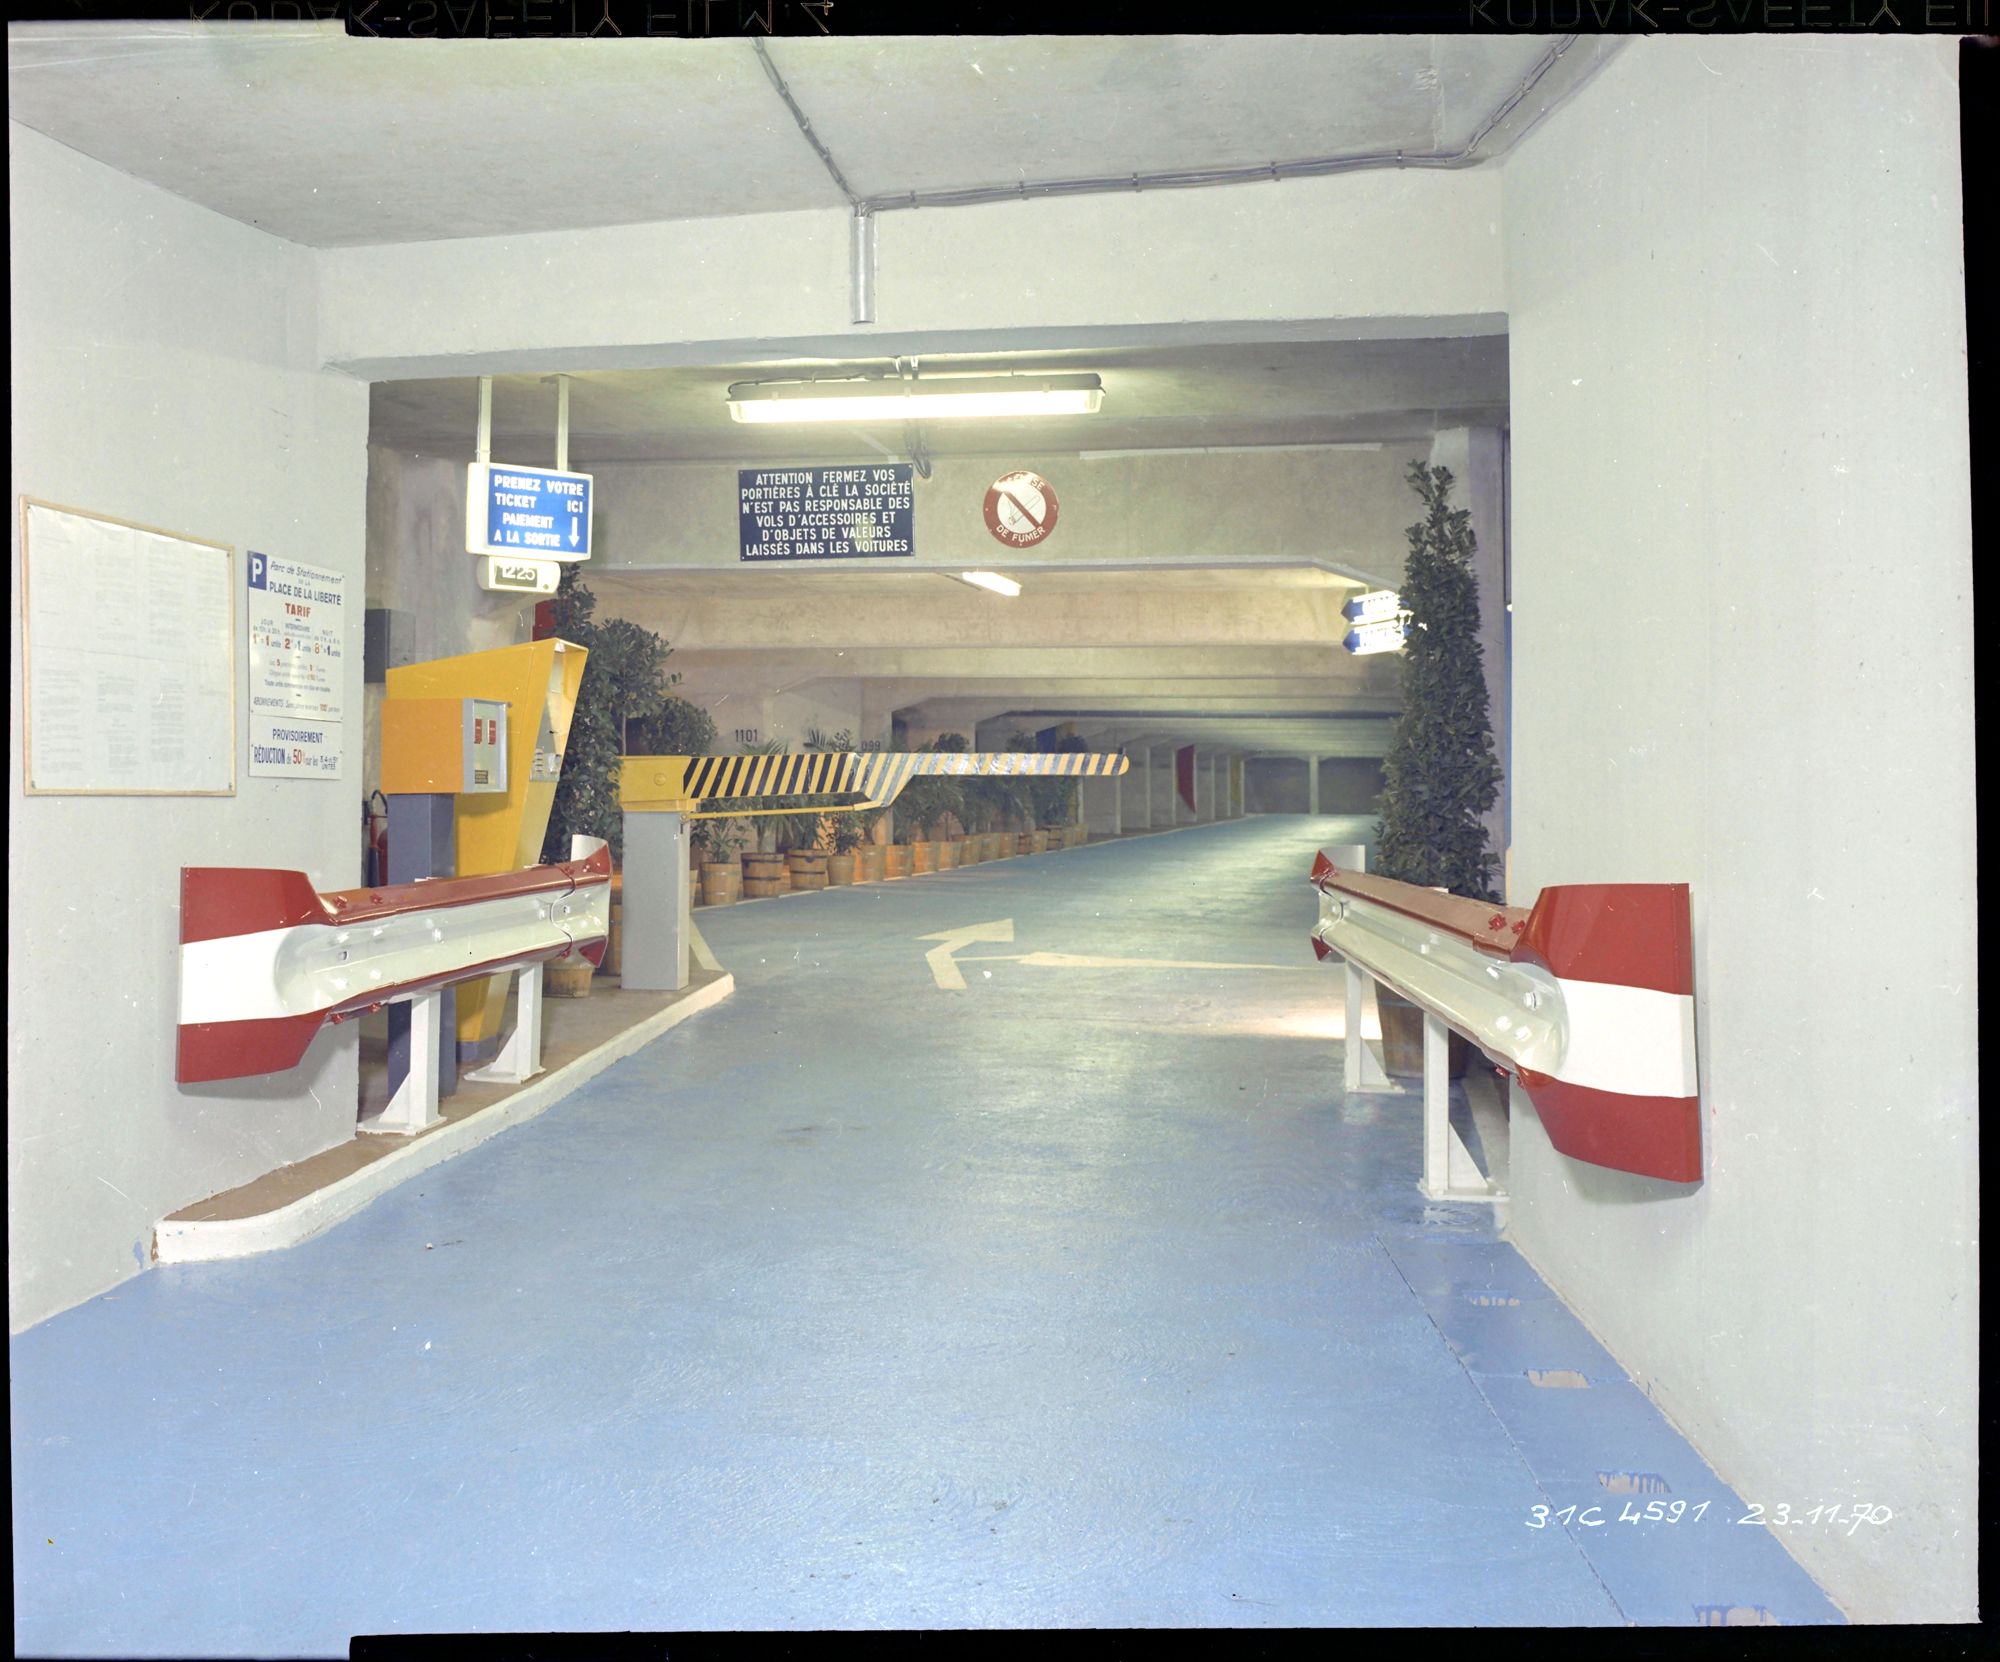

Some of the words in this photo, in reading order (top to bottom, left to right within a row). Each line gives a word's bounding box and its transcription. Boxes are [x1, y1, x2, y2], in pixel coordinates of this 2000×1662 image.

[494, 474, 541, 492] PRENEZ
[546, 480, 584, 496] VOTRE
[756, 472, 813, 486] ATTENTION
[823, 470, 866, 483] FERMEZ
[873, 469, 895, 481] VOS
[1030, 478, 1045, 490] SE
[819, 483, 839, 497] CLÉ
[846, 484, 859, 496] LA
[865, 480, 911, 496] SOCIÉTÉ
[495, 492, 537, 508] TICKET
[567, 500, 584, 513] ICI
[742, 501, 774, 514] N'EST
[779, 500, 800, 513] PAS
[805, 498, 883, 511] RESPONSABLE
[888, 497, 910, 509] DES
[502, 512, 554, 529] PAIEMENT
[756, 515, 784, 528] VOLS
[789, 512, 877, 526] D'ACCESSOIRES
[882, 511, 896, 523] ET
[494, 529, 502, 542] A
[506, 530, 520, 544] LA
[524, 531, 561, 547] SORTIE
[762, 528, 817, 541] D'OBJETS
[822, 527, 836, 539] DE
[842, 526, 891, 539] VALEURS
[996, 524, 1009, 538] DE
[1012, 526, 1046, 543] FUMER
[746, 541, 790, 556] LAISSÉS
[796, 542, 825, 554] DANS
[830, 541, 849, 554] LES
[855, 540, 908, 553] VOITURES
[252, 558, 263, 583] P
[270, 560, 285, 572] Parc
[287, 565, 295, 575] de
[296, 566, 342, 584] Stationnement
[269, 581, 292, 596] PLACE
[293, 586, 302, 598] DE
[303, 590, 312, 600] LA
[314, 590, 341, 606] LIBERTÉ
[285, 602, 311, 618] TARIF
[272, 728, 323, 744] PROVISOIREMENT
[735, 728, 758, 743] 1101
[254, 744, 286, 764] RÉDUCTION
